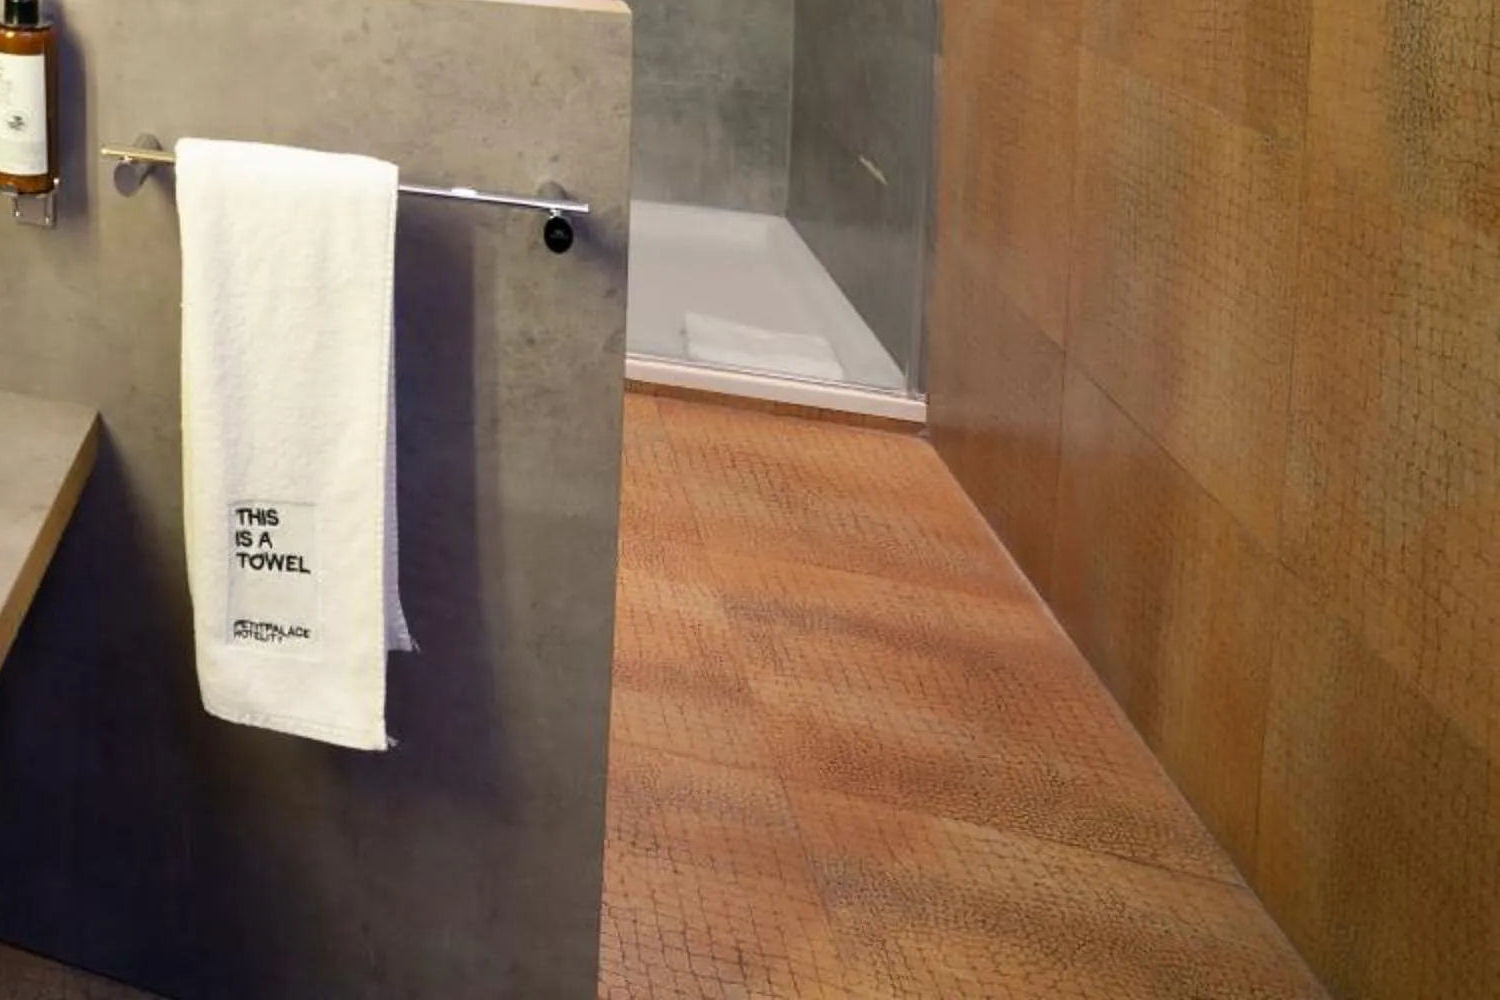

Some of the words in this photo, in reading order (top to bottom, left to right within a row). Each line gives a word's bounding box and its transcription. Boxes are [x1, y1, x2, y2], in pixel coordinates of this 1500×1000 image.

[235, 508, 280, 526] THIS
[235, 530, 253, 547] IS
[258, 531, 273, 549] A
[236, 552, 311, 575] TOWEL
